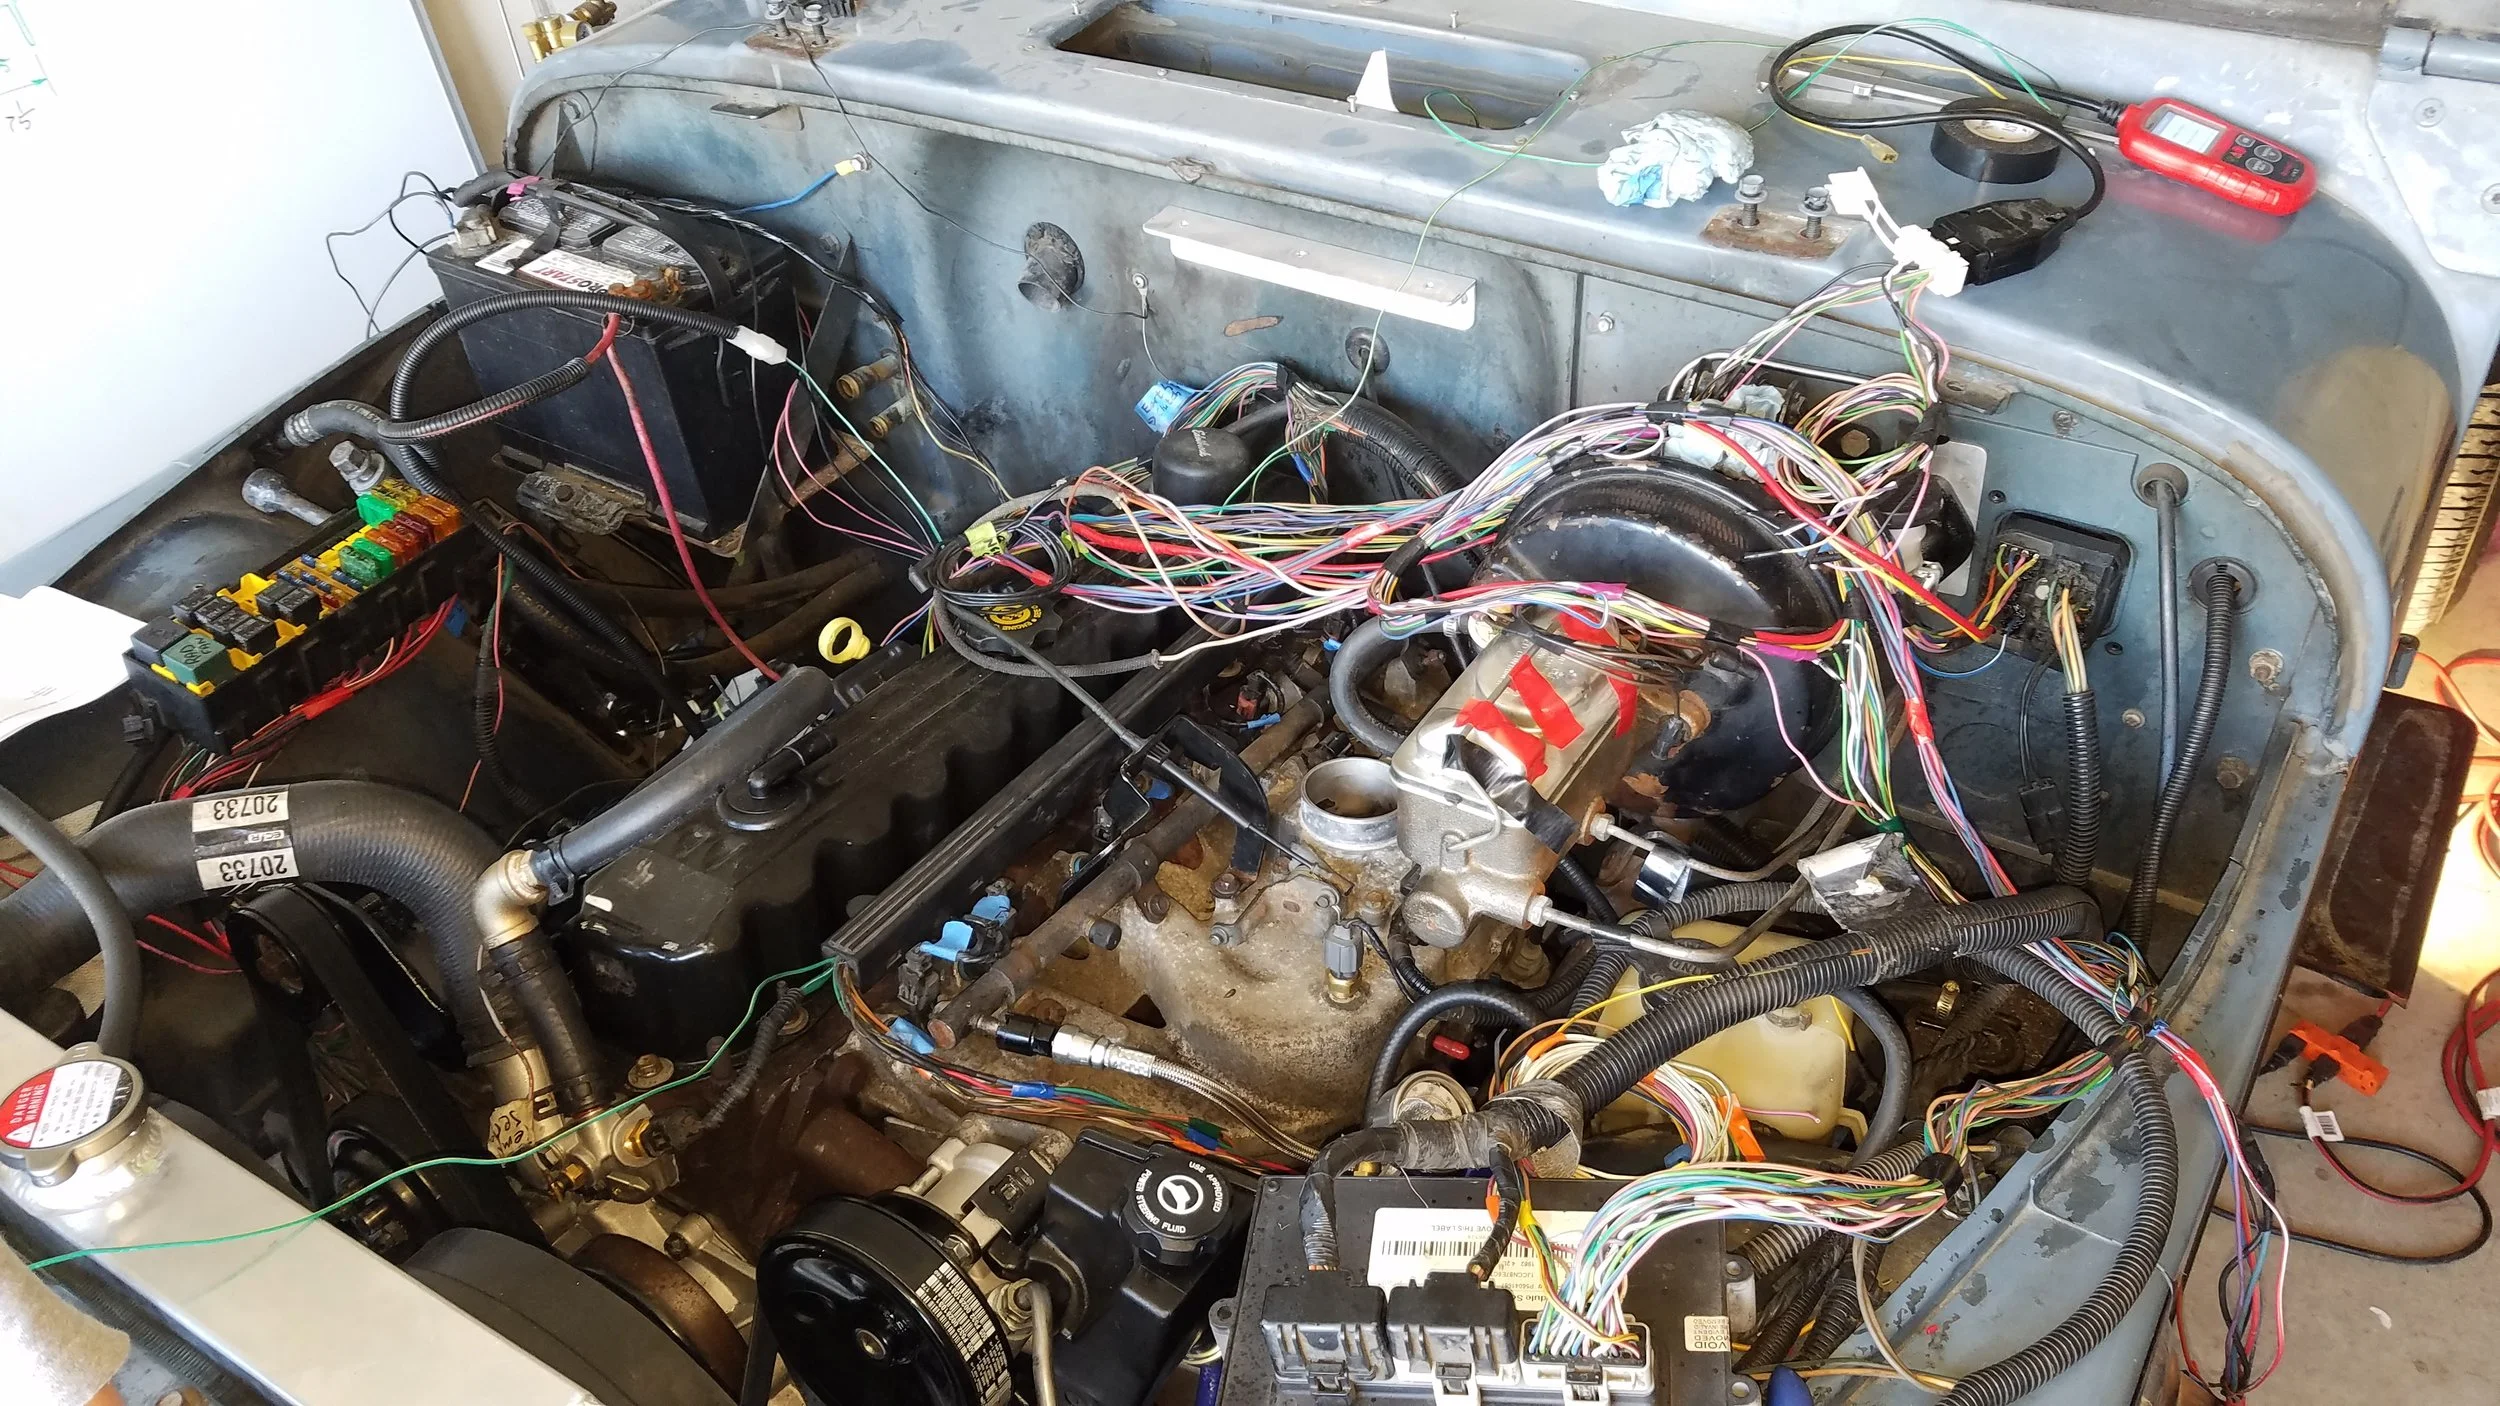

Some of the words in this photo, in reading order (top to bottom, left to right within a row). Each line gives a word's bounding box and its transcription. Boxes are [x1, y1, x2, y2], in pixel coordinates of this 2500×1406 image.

[213, 794, 279, 821] 20733
[218, 854, 288, 883] 20733
[10, 1085, 34, 1124] DANGER
[24, 1083, 47, 1121] WARNING
[1135, 1168, 1153, 1193] POWER
[1189, 1161, 1206, 1173] USE
[1206, 1173, 1223, 1213] APPROVED
[1136, 1194, 1160, 1225] STEERING
[1161, 1222, 1187, 1234] FLUID
[1431, 1224, 1456, 1233] LABEL
[1457, 1225, 1474, 1233] THIS
[1694, 1341, 1727, 1349] VOID
